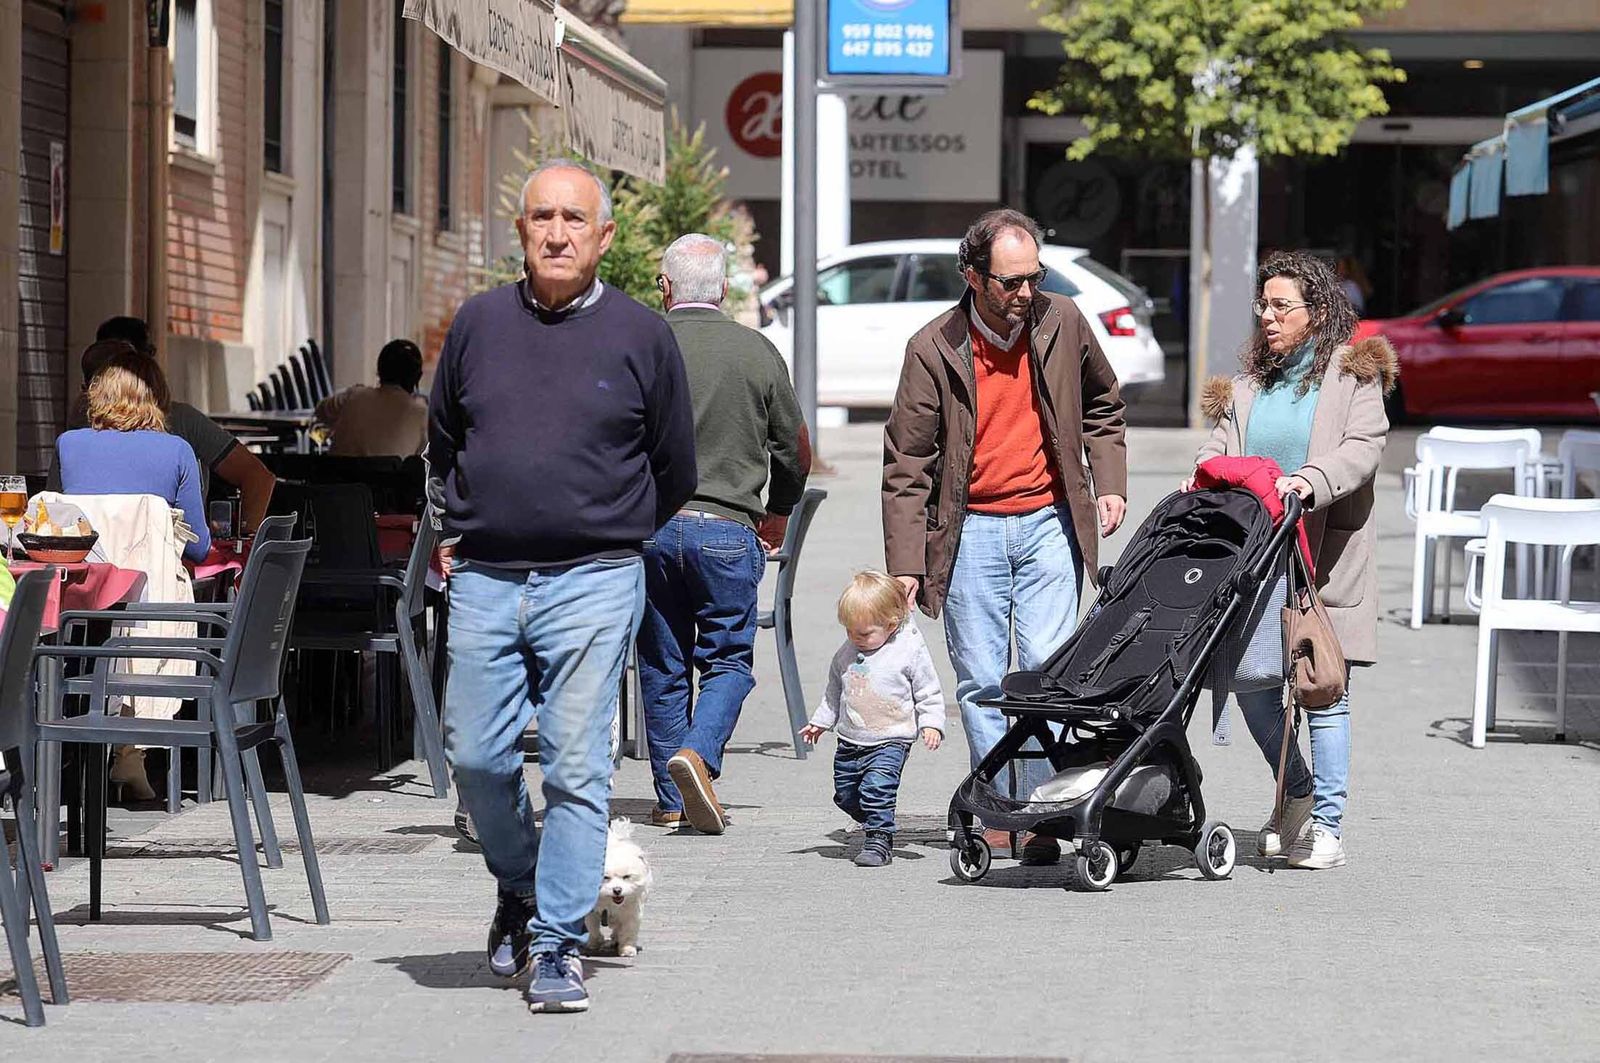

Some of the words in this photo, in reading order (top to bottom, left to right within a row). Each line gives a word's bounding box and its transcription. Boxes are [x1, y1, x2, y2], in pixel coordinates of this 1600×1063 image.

[842, 23, 871, 40] 959
[905, 23, 934, 40] 996
[842, 41, 870, 57] 647
[849, 133, 966, 152] ARTESSOS
[849, 160, 906, 178] OTEL
